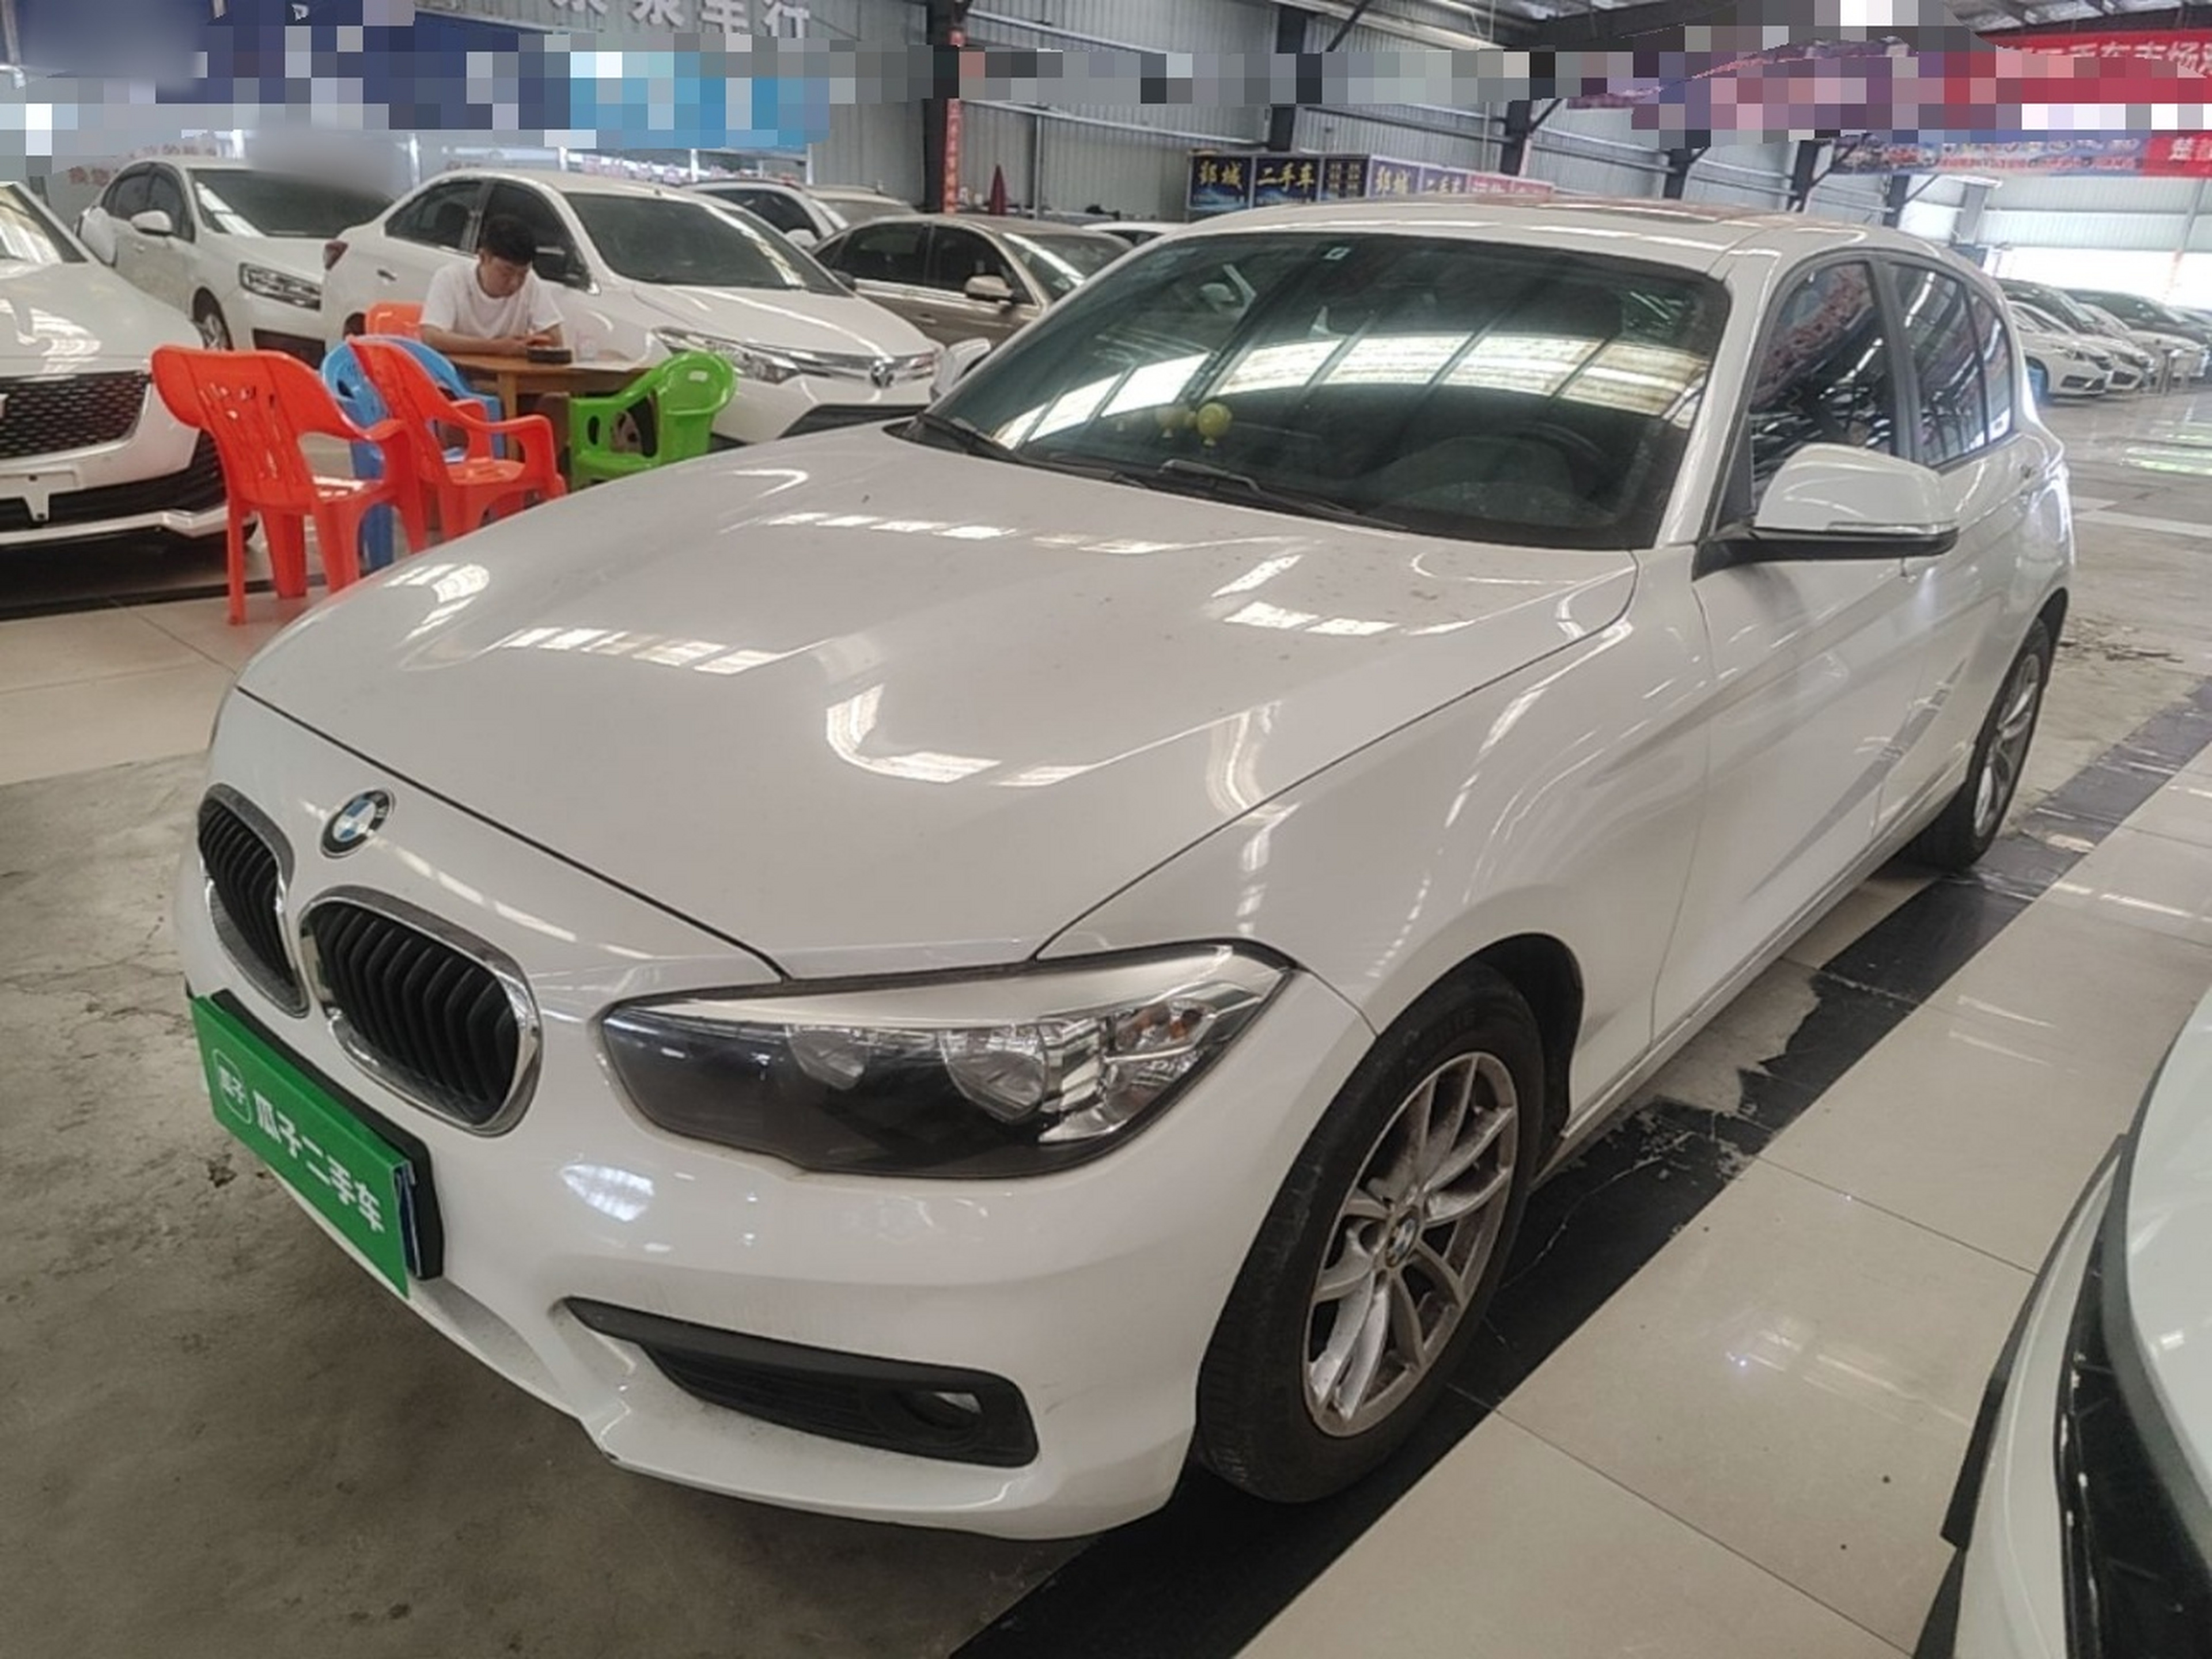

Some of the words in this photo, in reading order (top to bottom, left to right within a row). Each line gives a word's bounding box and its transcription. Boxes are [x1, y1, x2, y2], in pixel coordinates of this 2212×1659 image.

[252, 1089, 385, 1232] 瓜子二手车
